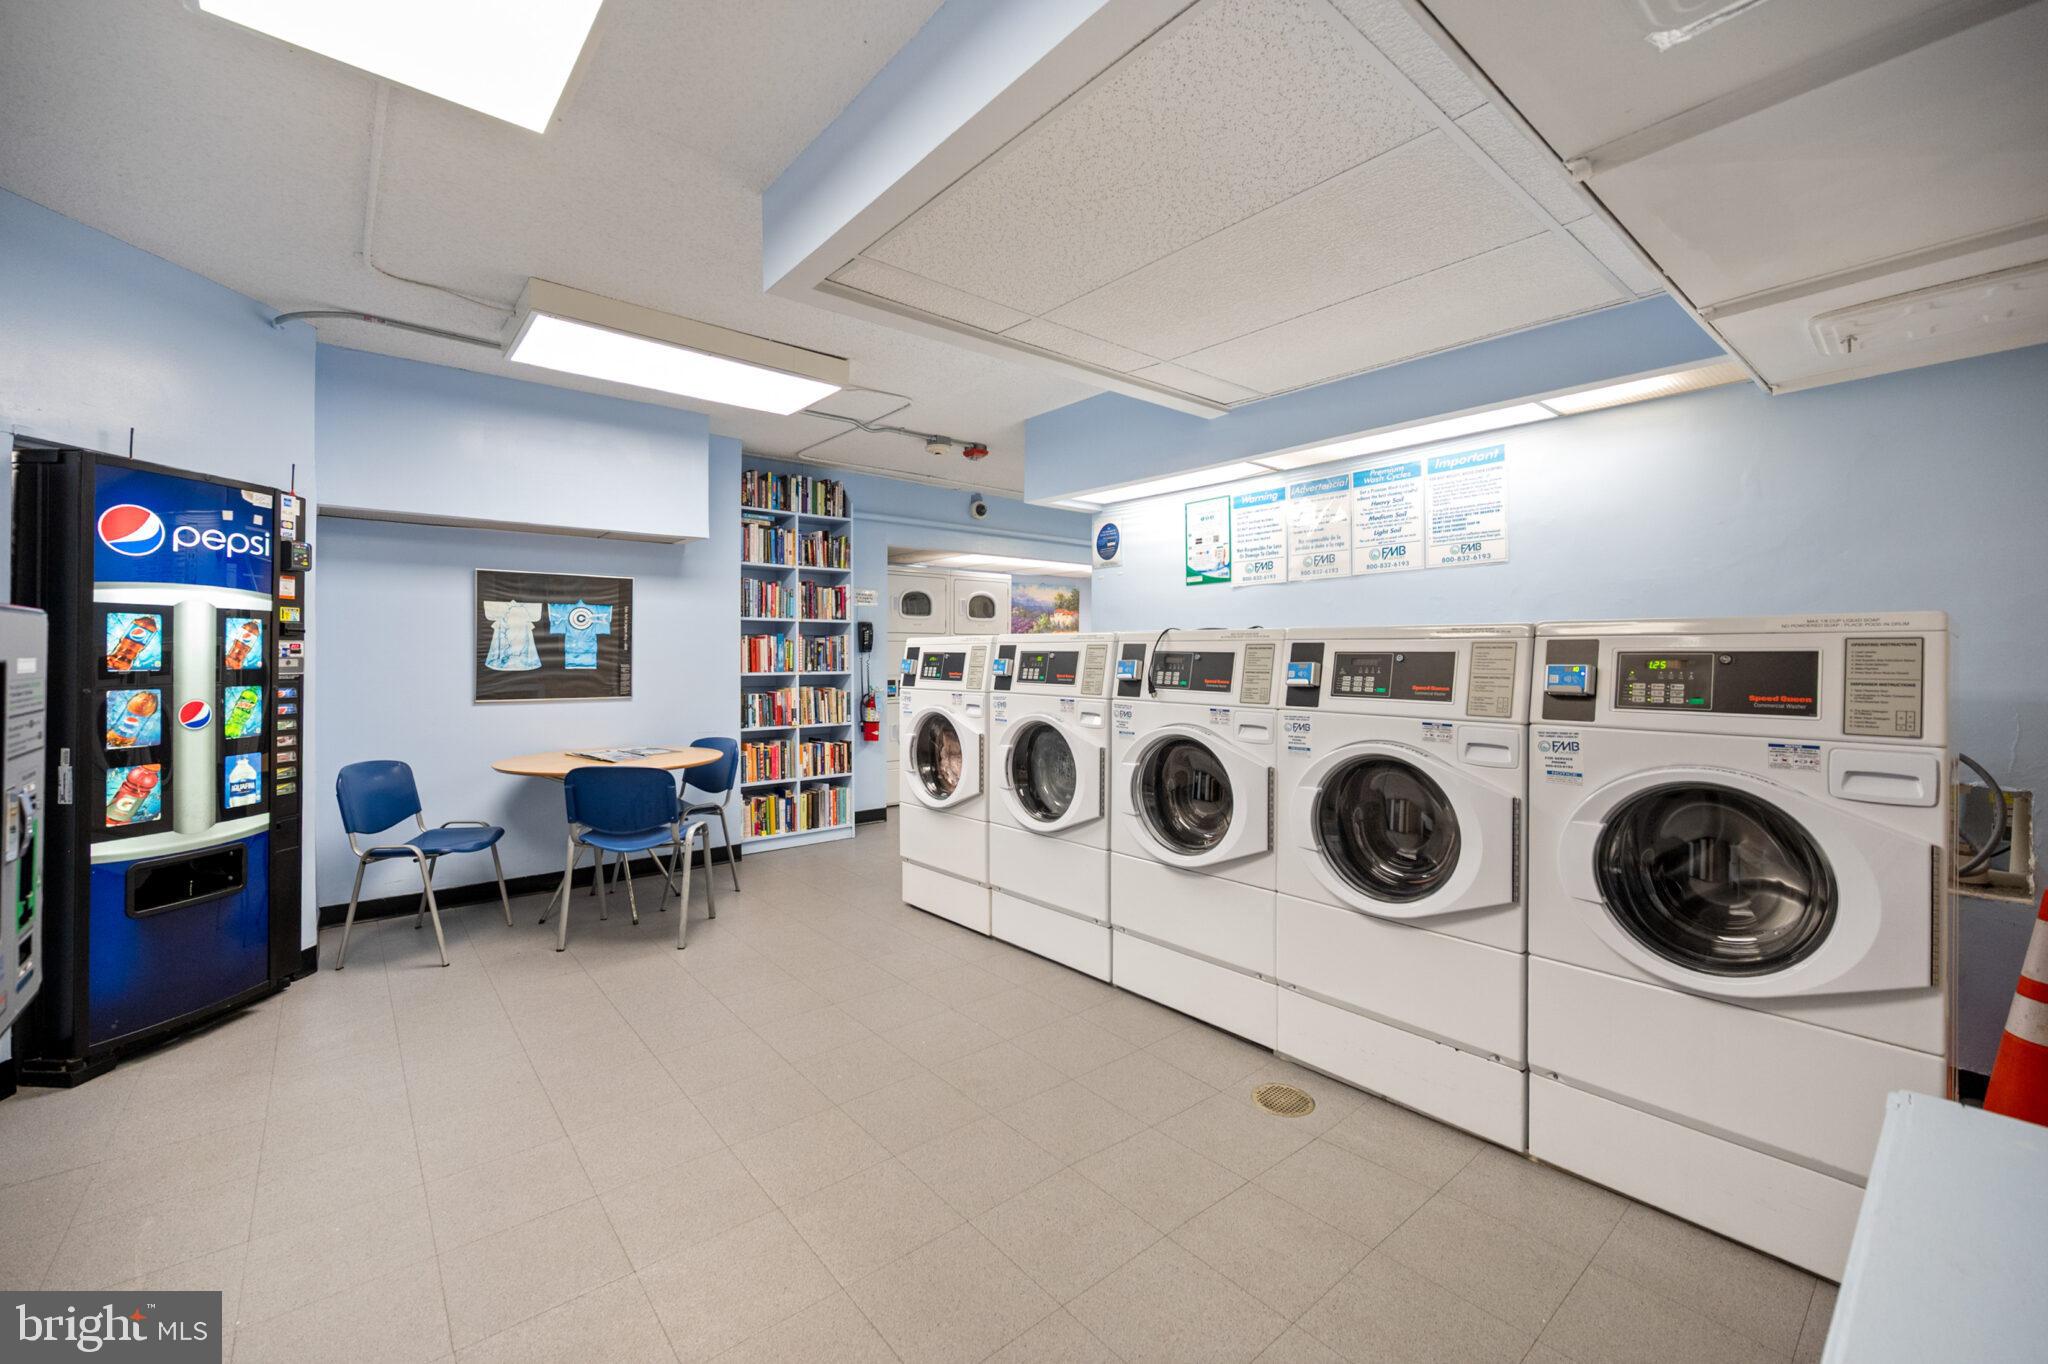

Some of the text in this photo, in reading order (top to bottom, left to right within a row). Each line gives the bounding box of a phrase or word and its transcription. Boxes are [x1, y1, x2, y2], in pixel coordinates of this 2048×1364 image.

[1434, 448, 1500, 470] Important
[1369, 465, 1405, 476] Premium
[1363, 471, 1412, 484] Wash Cycles
[1240, 490, 1279, 505] Warning
[1370, 499, 1391, 507] Heavy
[1368, 510, 1408, 522] Medium Soil
[1373, 526, 1402, 537] Light Soil
[172, 525, 270, 558] pepsi
[1381, 545, 1406, 560] FMB
[1460, 542, 1482, 554] FMB
[1313, 553, 1335, 567] FMB
[1441, 553, 1491, 563] 800-832-6193
[1254, 560, 1274, 573] FMB
[1366, 561, 1409, 570] 800-832-6193
[1749, 695, 1813, 703] Speed Queen
[1293, 722, 1311, 732] FMB
[1552, 741, 1580, 753] FMB
